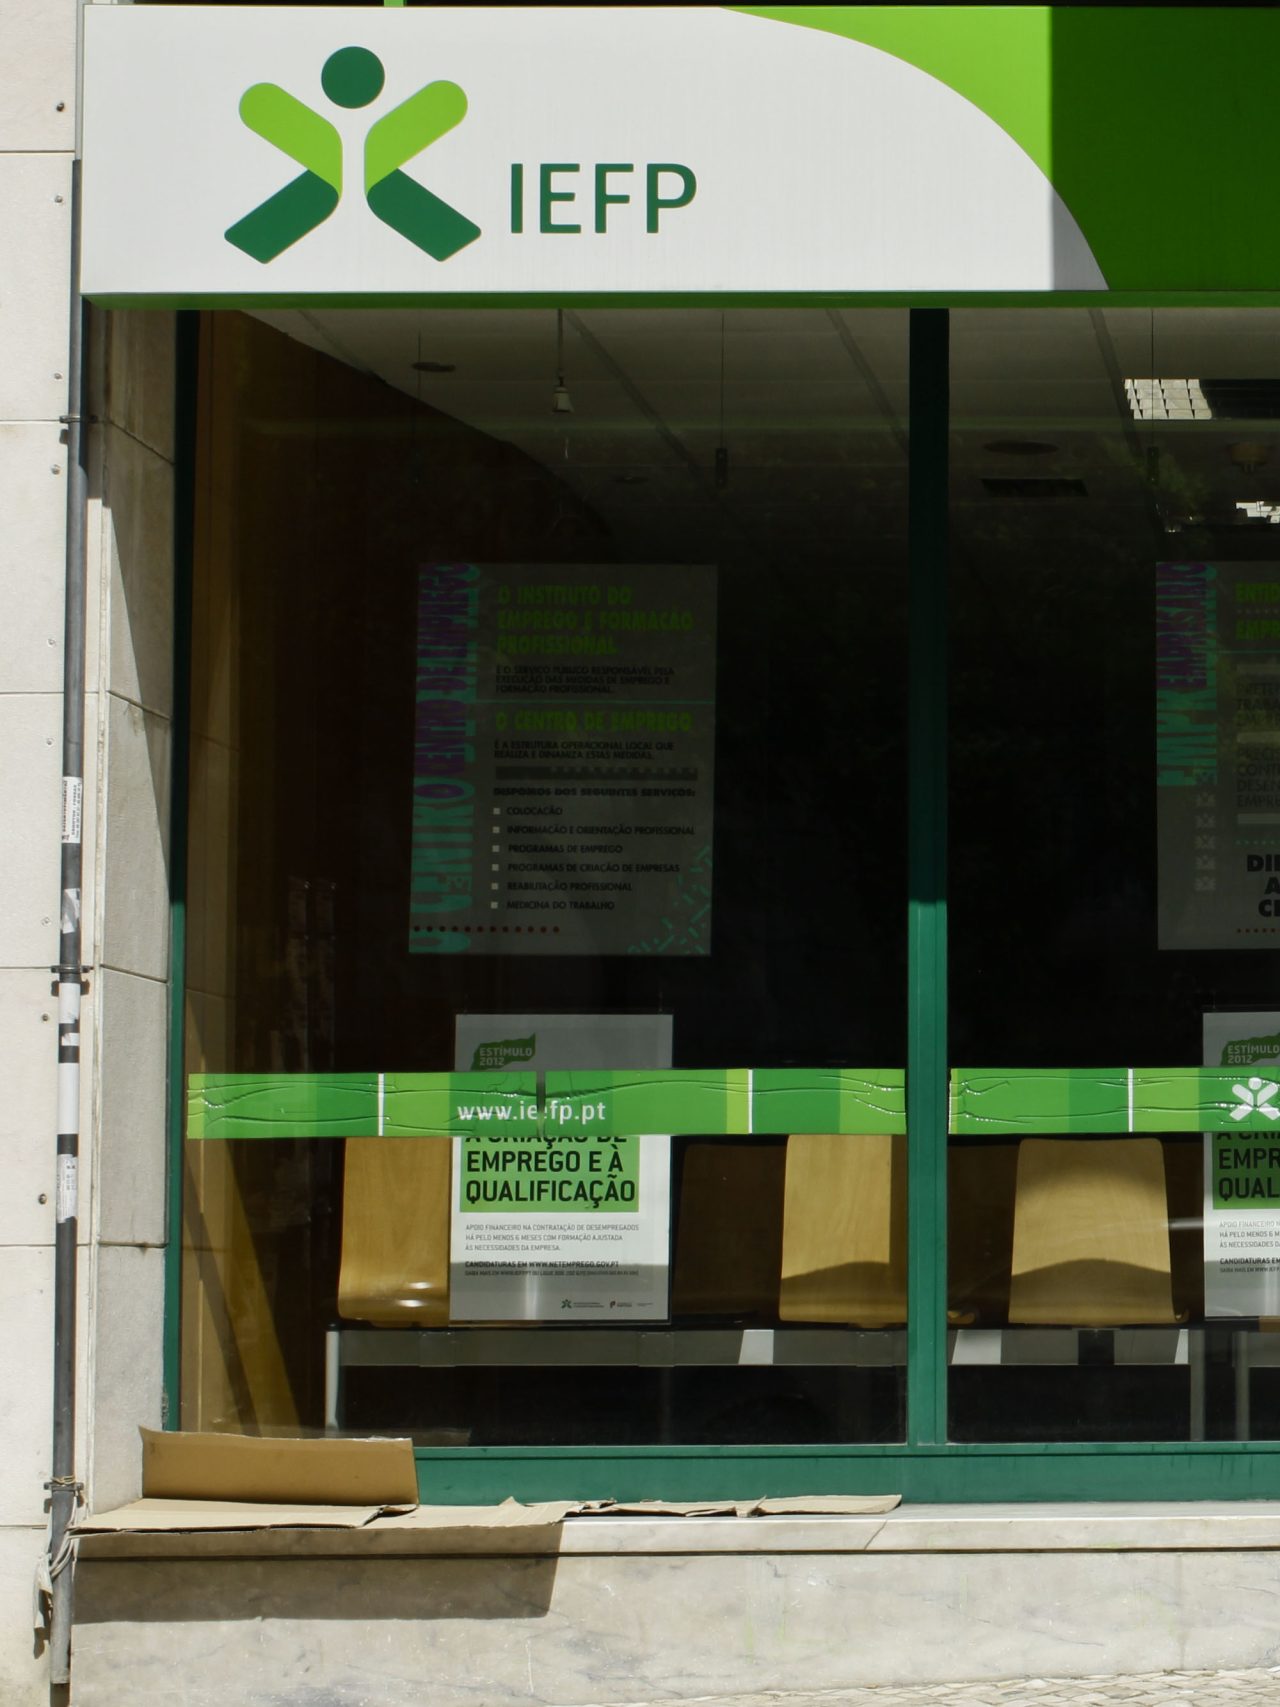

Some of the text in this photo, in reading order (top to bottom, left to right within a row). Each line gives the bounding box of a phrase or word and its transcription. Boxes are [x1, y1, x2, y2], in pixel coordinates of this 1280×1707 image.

[511, 163, 697, 233] IEFP
[479, 1044, 533, 1057] ESTÍMULO
[1227, 1042, 1280, 1055] ESTÍMULO
[479, 1056, 505, 1066] 2012
[1227, 1054, 1253, 1064] 2012
[466, 1143, 624, 1172] EMPREGO E À
[465, 1174, 635, 1208] QUALIFICAÇÃO
[466, 1223, 639, 1233] APOIO FINANCEIRO NA CONTRATAÇÃO DE DESEMPREGADOS
[466, 1233, 475, 1241] HÁ
[558, 1233, 591, 1243] FORMAÇÃO
[1219, 1230, 1228, 1239] HÁ
[1219, 1257, 1271, 1265] CANDIDATURAS
